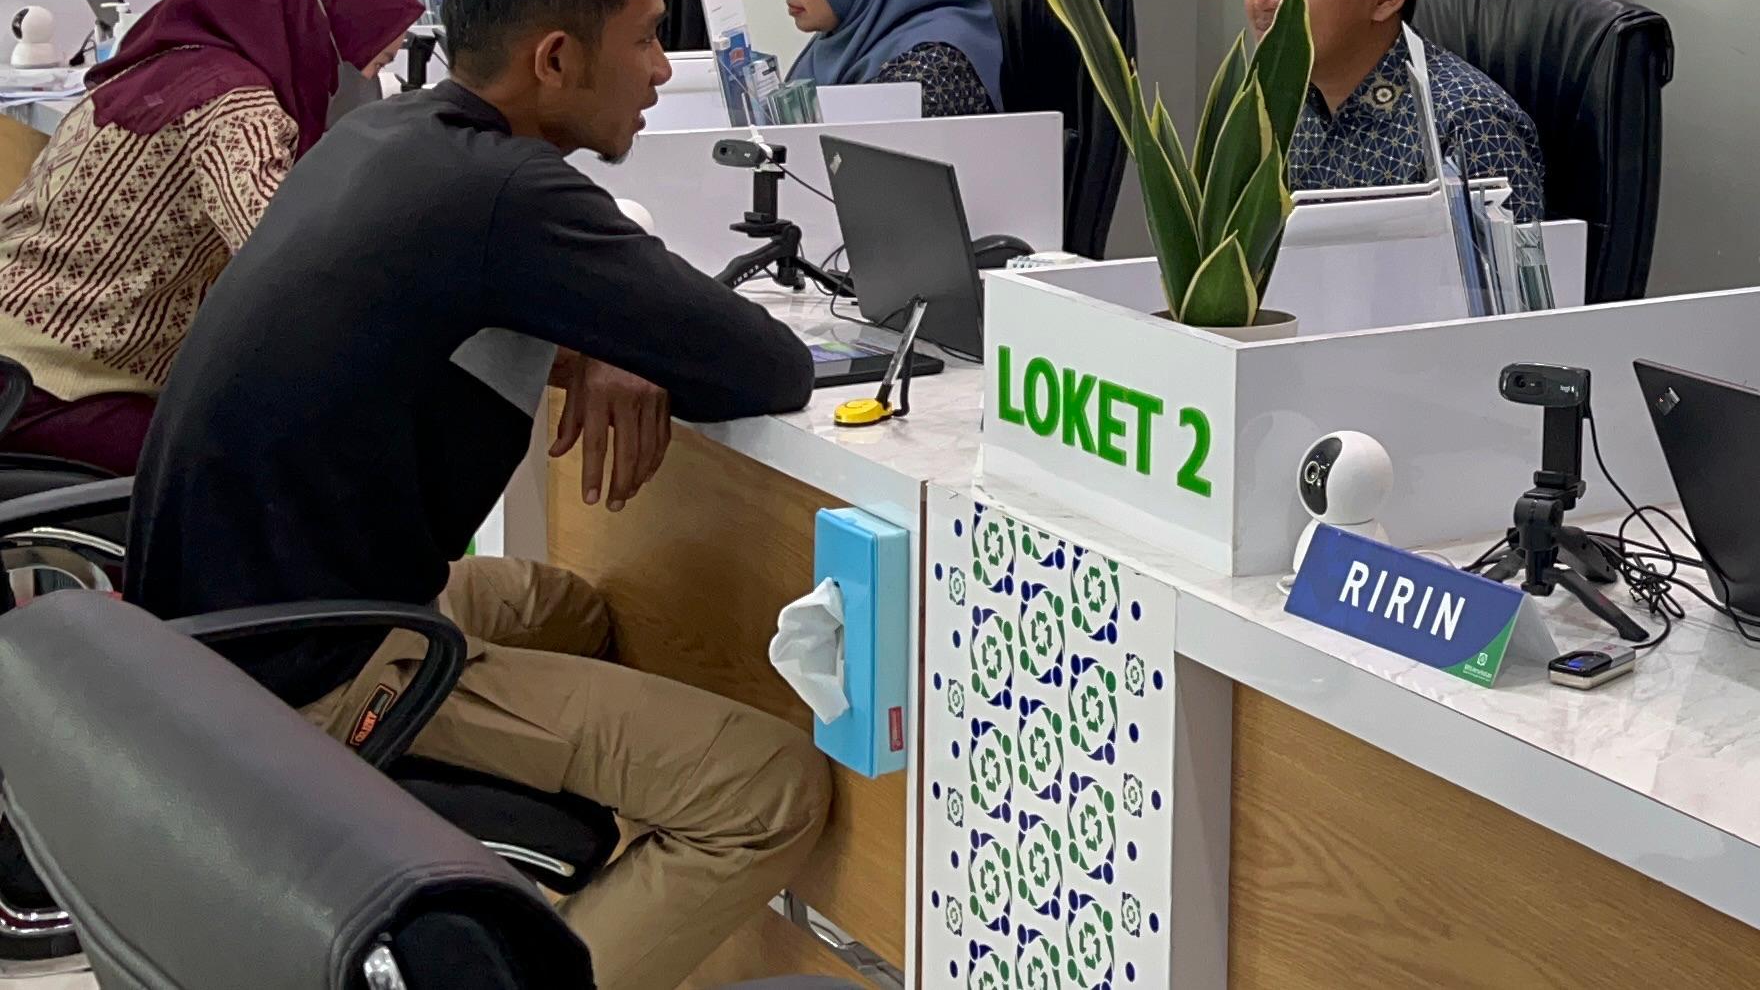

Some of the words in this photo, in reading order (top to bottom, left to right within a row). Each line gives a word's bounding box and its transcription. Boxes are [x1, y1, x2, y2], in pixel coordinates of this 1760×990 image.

[997, 345, 1164, 475] LOKET
[1176, 406, 1212, 498] 2
[1338, 560, 1466, 641] RIRIN
